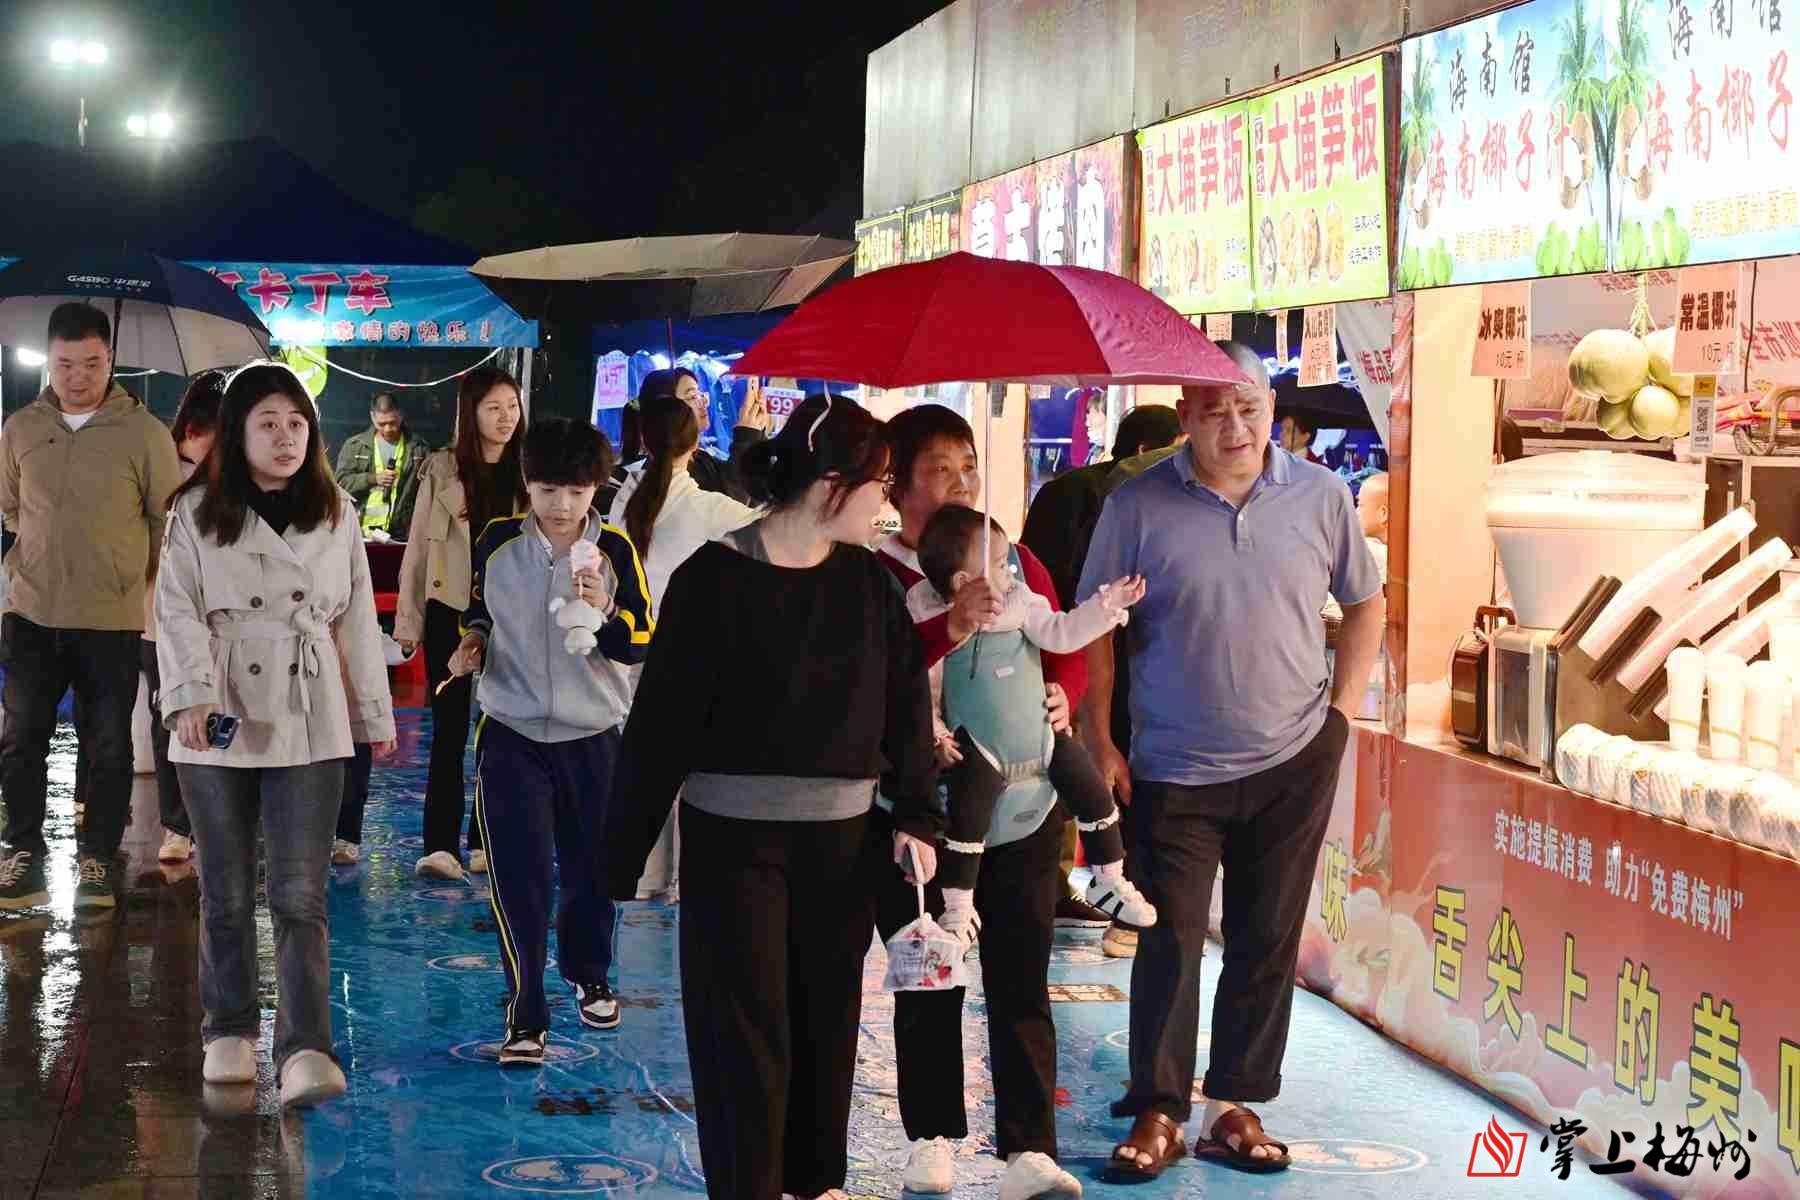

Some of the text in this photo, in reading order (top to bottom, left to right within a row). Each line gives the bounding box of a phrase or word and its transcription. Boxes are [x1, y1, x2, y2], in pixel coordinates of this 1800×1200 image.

[1449, 30, 1535, 113] 海南馆
[1645, 49, 1793, 174] 海南椰子
[1426, 103, 1570, 208] 海南椰子汁
[1320, 838, 1349, 944] 味
[1495, 809, 1593, 887] 实施提振消费
